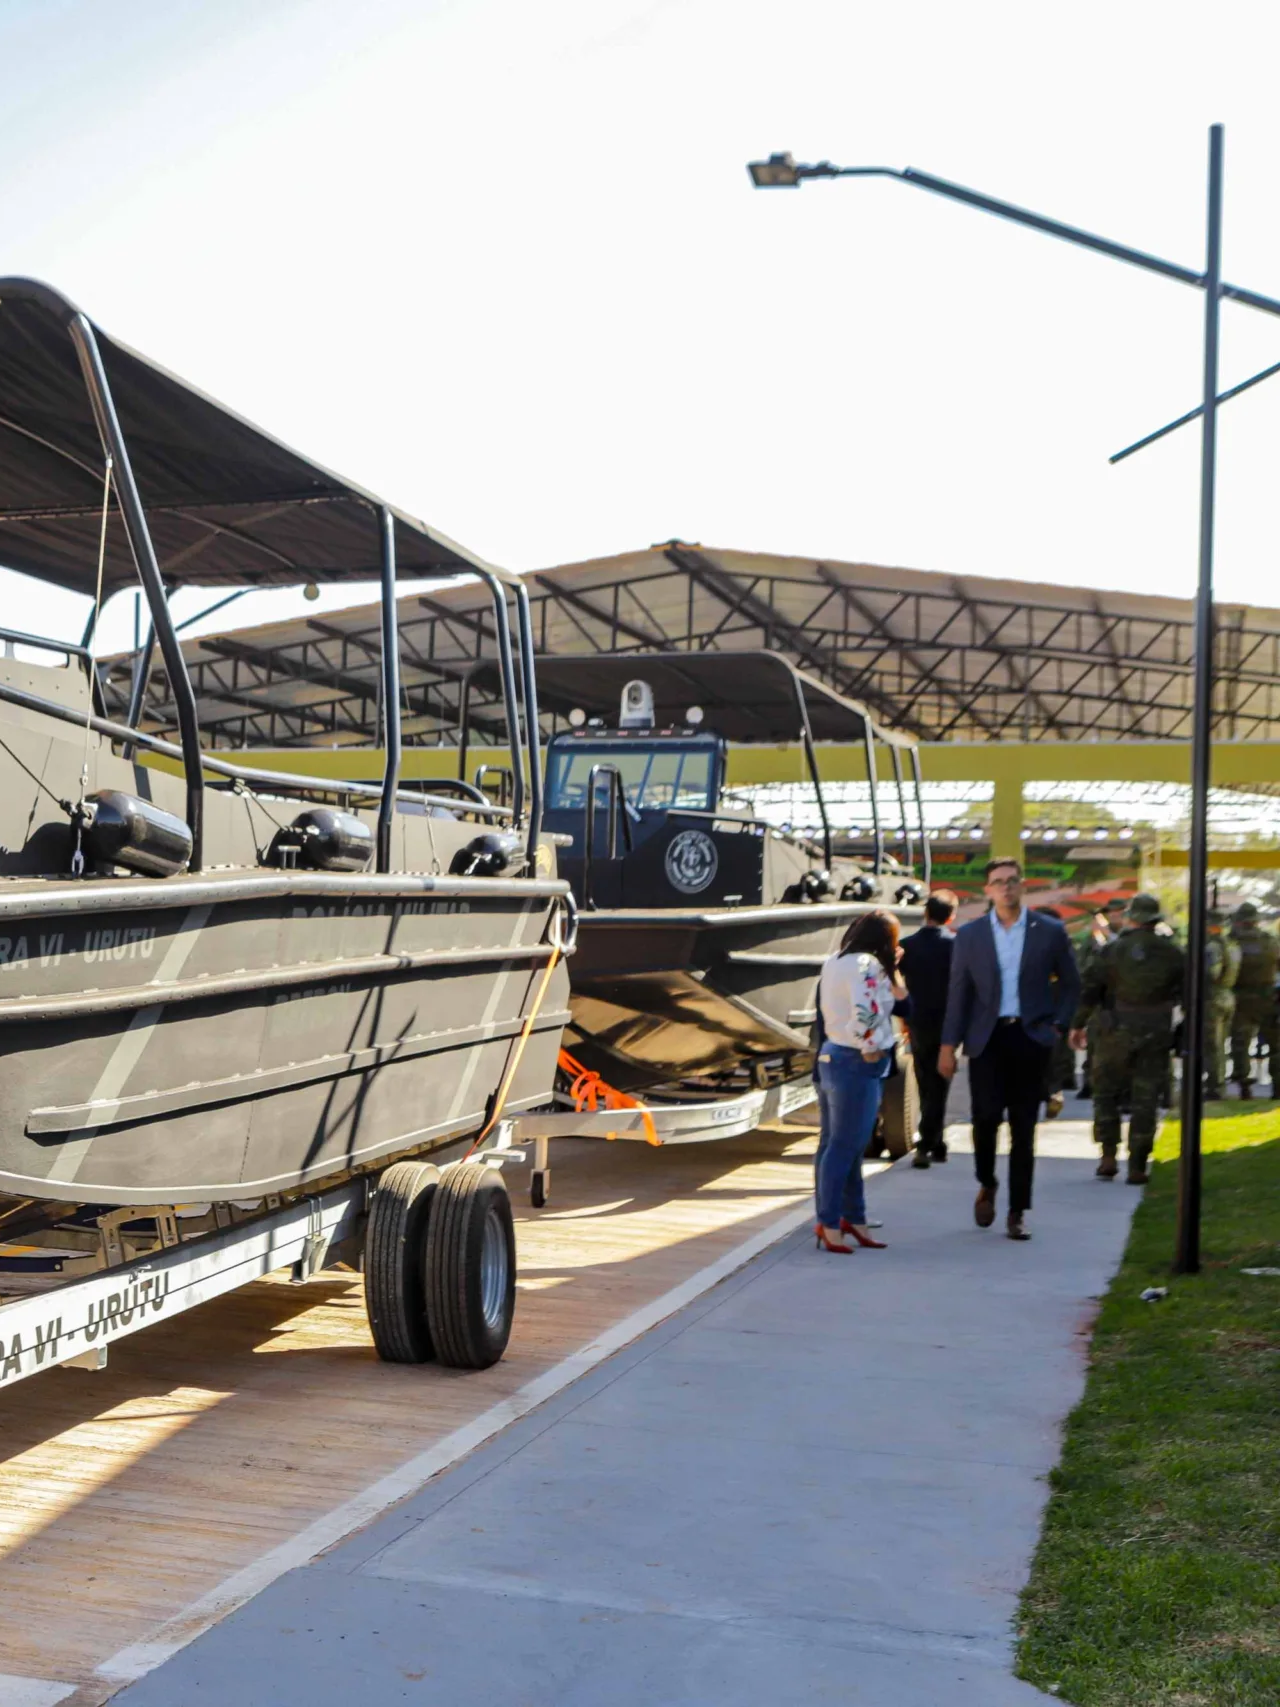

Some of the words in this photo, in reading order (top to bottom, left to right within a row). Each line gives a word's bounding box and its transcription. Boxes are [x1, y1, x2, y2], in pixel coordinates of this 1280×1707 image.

[40, 933, 64, 968] VI
[83, 927, 156, 964] URUTU
[35, 1316, 62, 1365] VI
[84, 1271, 169, 1343] URUTU
